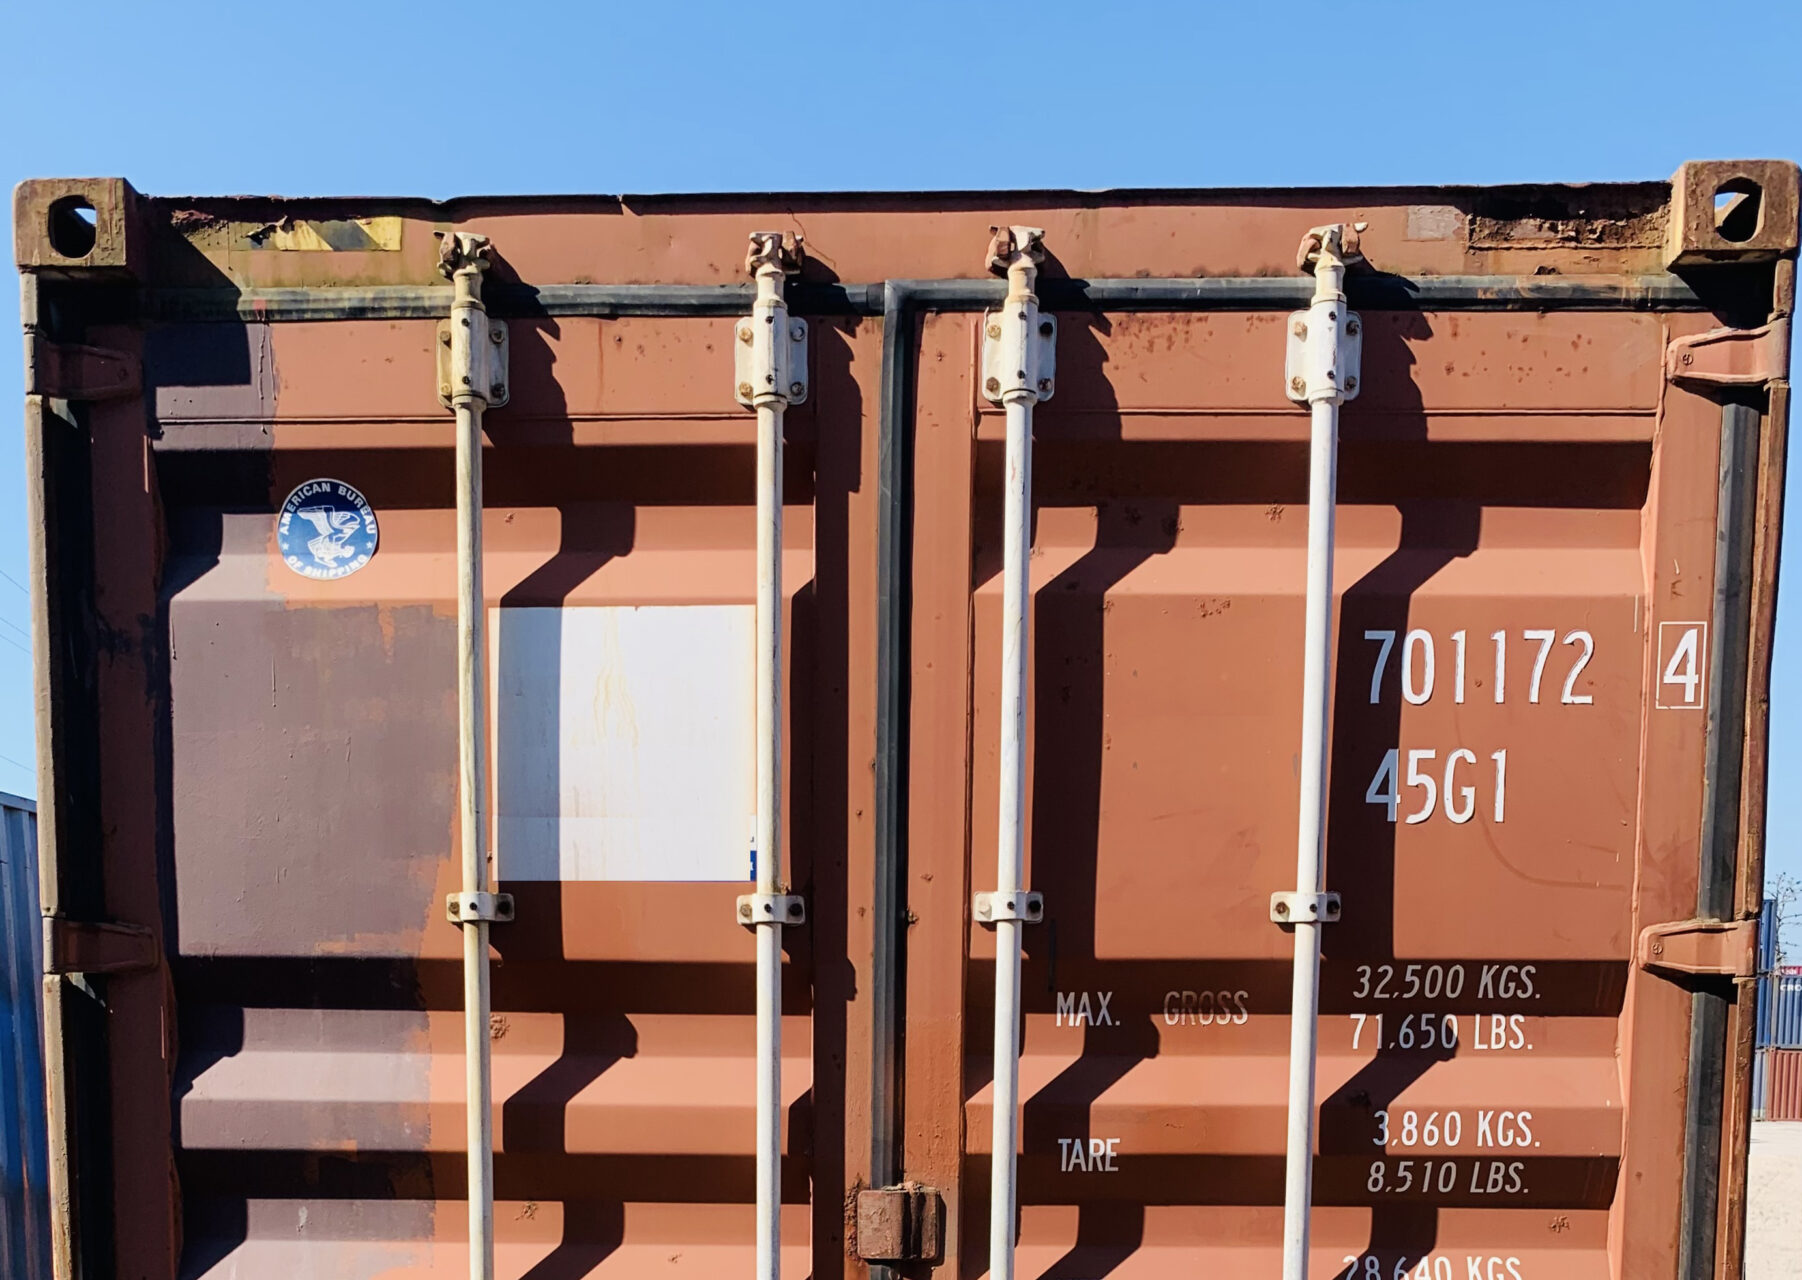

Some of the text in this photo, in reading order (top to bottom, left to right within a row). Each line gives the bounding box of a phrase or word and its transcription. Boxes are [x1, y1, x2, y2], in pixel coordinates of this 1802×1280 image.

[280, 482, 376, 536] AMERICAN BUREAU
[1364, 628, 1699, 705] 701172 4
[1365, 748, 1507, 824] 45G1
[1353, 964, 1541, 999] 32,500 KGS.
[1056, 990, 1249, 1027] MAX. GROSS
[1350, 1013, 1533, 1050] 71,650 LBS.
[1372, 1110, 1541, 1147] 3,860 KGS.
[1057, 1138, 1120, 1172] TARE
[1367, 1161, 1529, 1194] 8,510 LBS.
